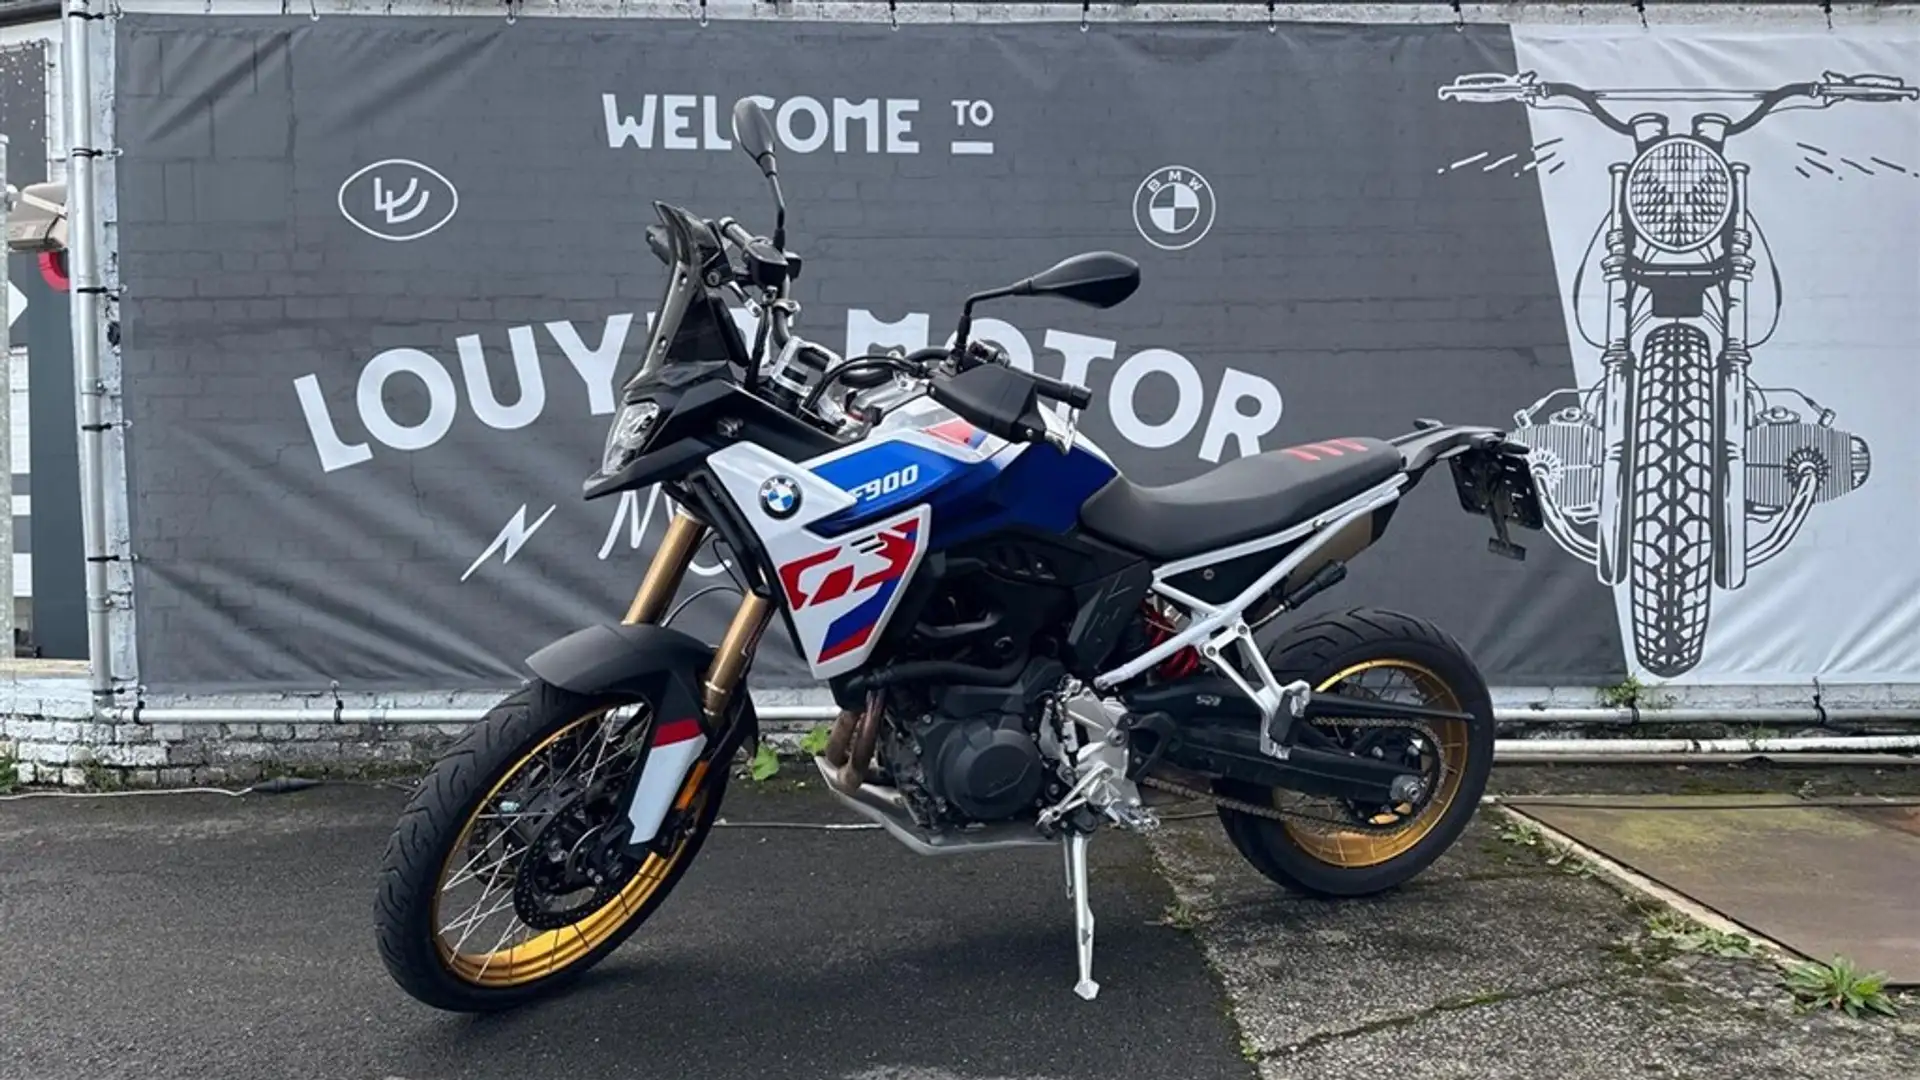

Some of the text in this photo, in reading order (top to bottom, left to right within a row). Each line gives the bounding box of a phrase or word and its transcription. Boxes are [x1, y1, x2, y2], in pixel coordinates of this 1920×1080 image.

[951, 99, 993, 126] TO
[1147, 170, 1203, 192] BMW
[293, 308, 794, 473] LOUY
[847, 463, 919, 501] F900
